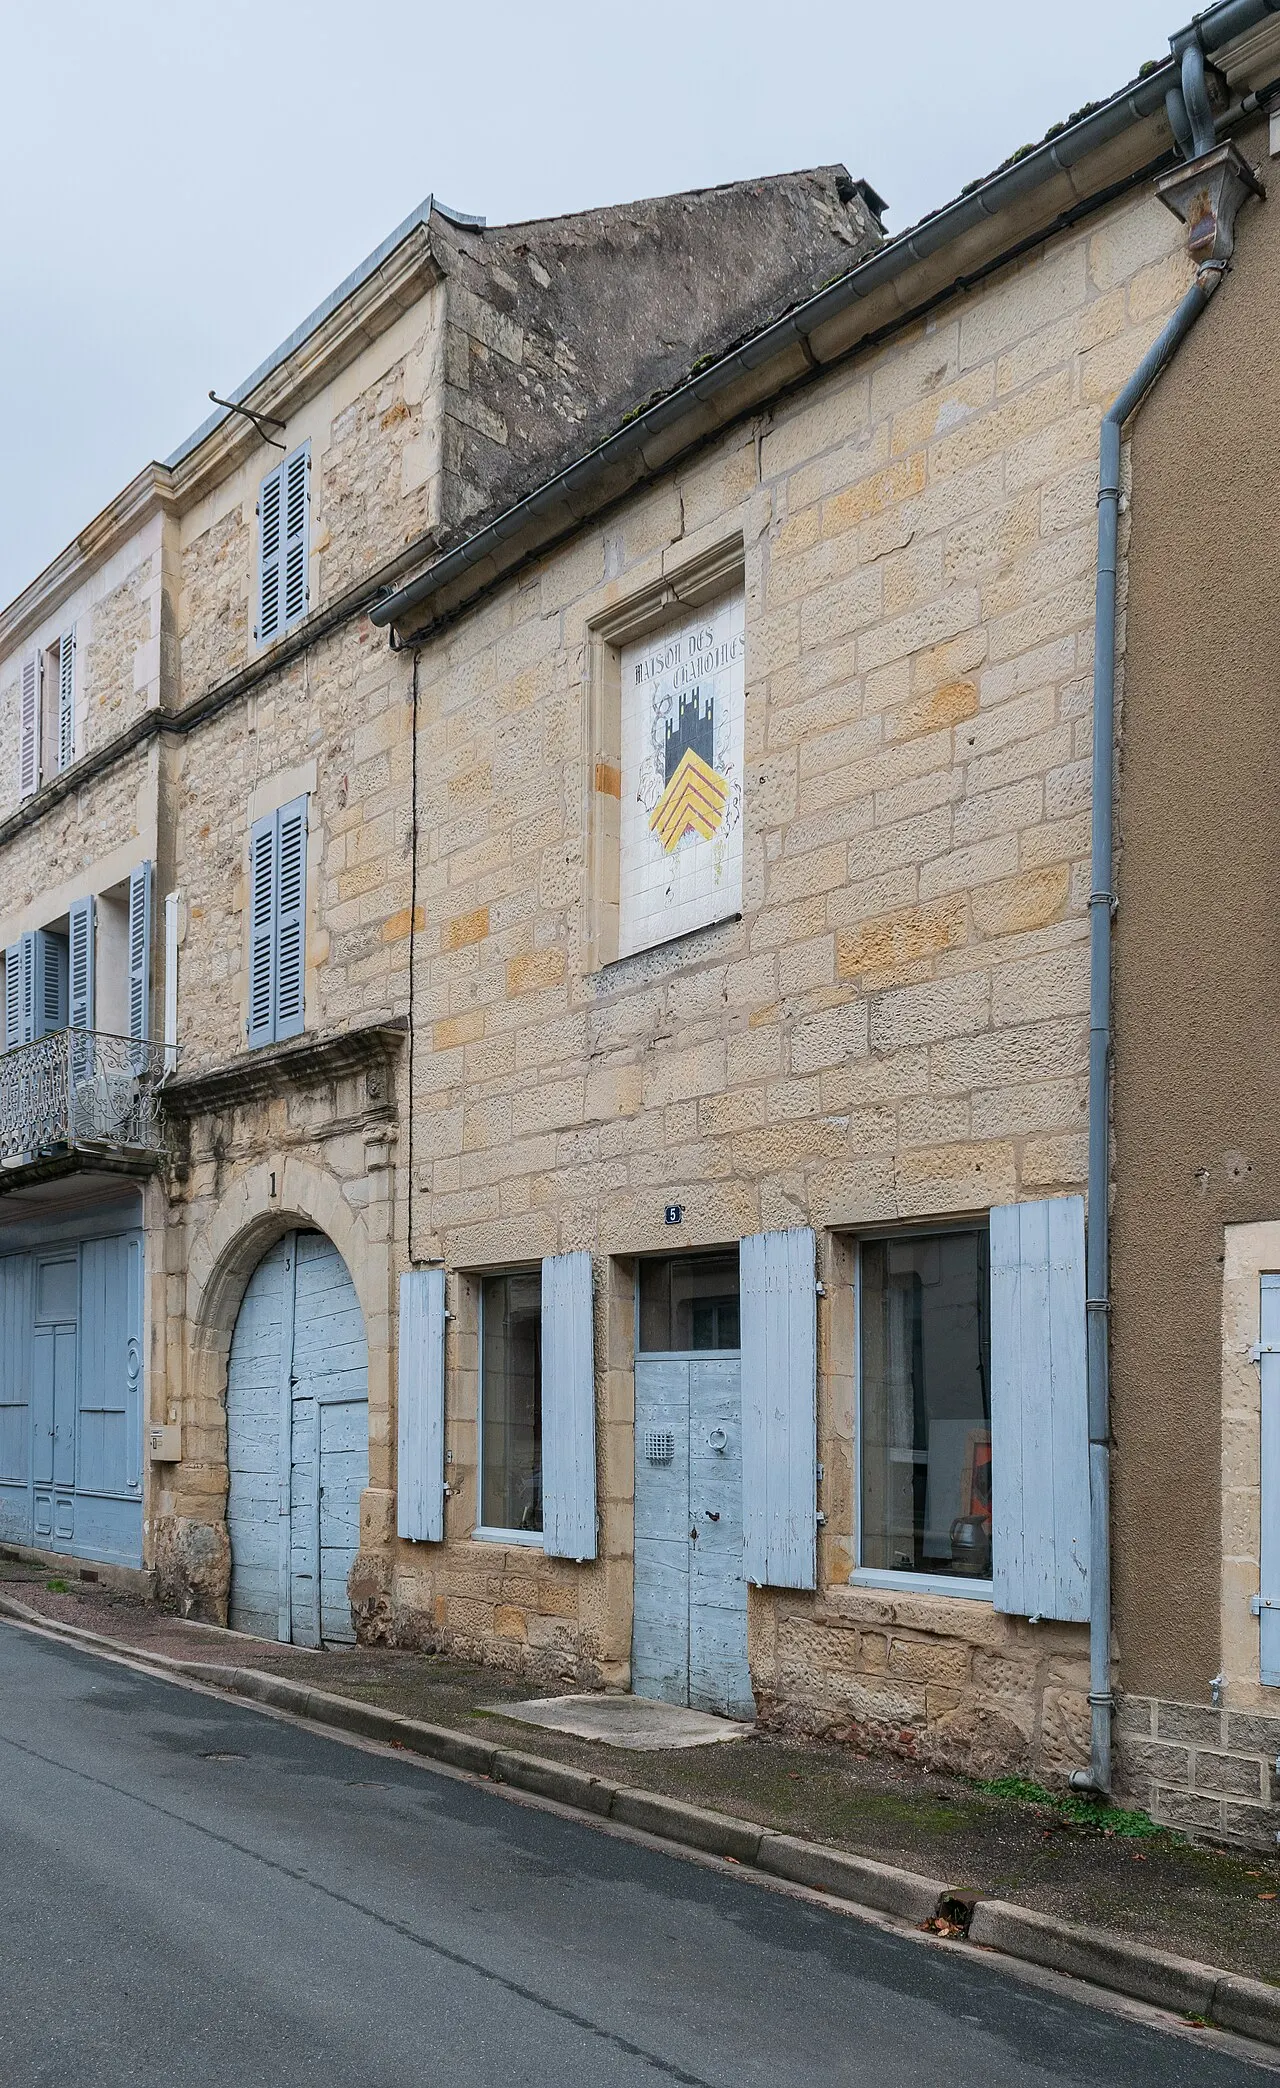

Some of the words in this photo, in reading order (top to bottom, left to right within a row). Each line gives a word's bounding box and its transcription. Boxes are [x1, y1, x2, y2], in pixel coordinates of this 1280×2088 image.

[635, 643, 681, 685] MAISON
[688, 626, 713, 656] DES
[269, 1171, 277, 1198] 1
[670, 1207, 676, 1221] 5
[285, 1258, 291, 1272] 3
